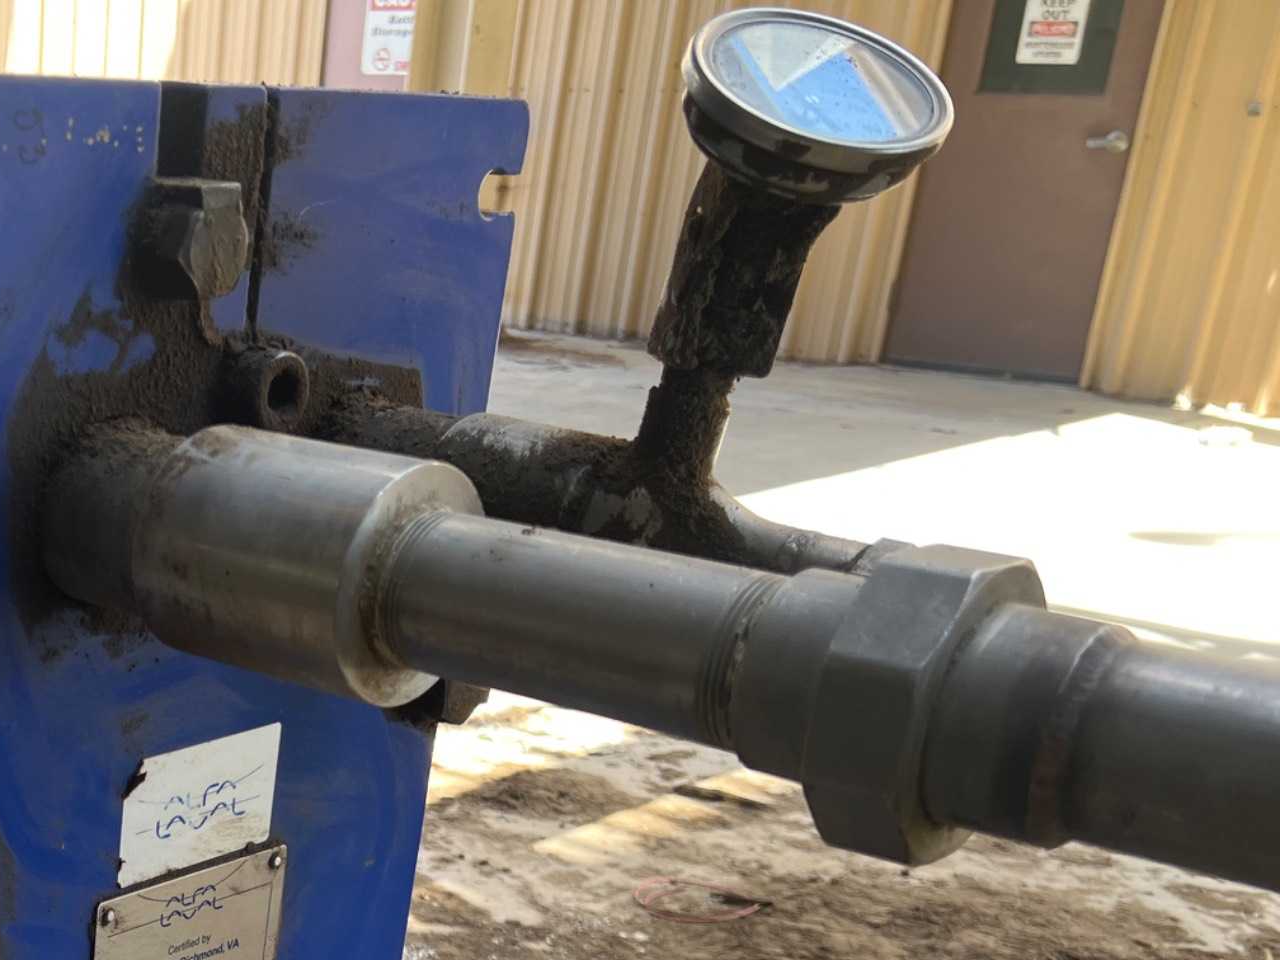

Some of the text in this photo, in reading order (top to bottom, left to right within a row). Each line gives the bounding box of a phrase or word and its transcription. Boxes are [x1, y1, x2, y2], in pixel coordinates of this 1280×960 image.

[166, 884, 217, 907] ALFA
[160, 896, 224, 928] LAVAL
[167, 935, 213, 956] Certified by
[226, 938, 241, 950] VA
